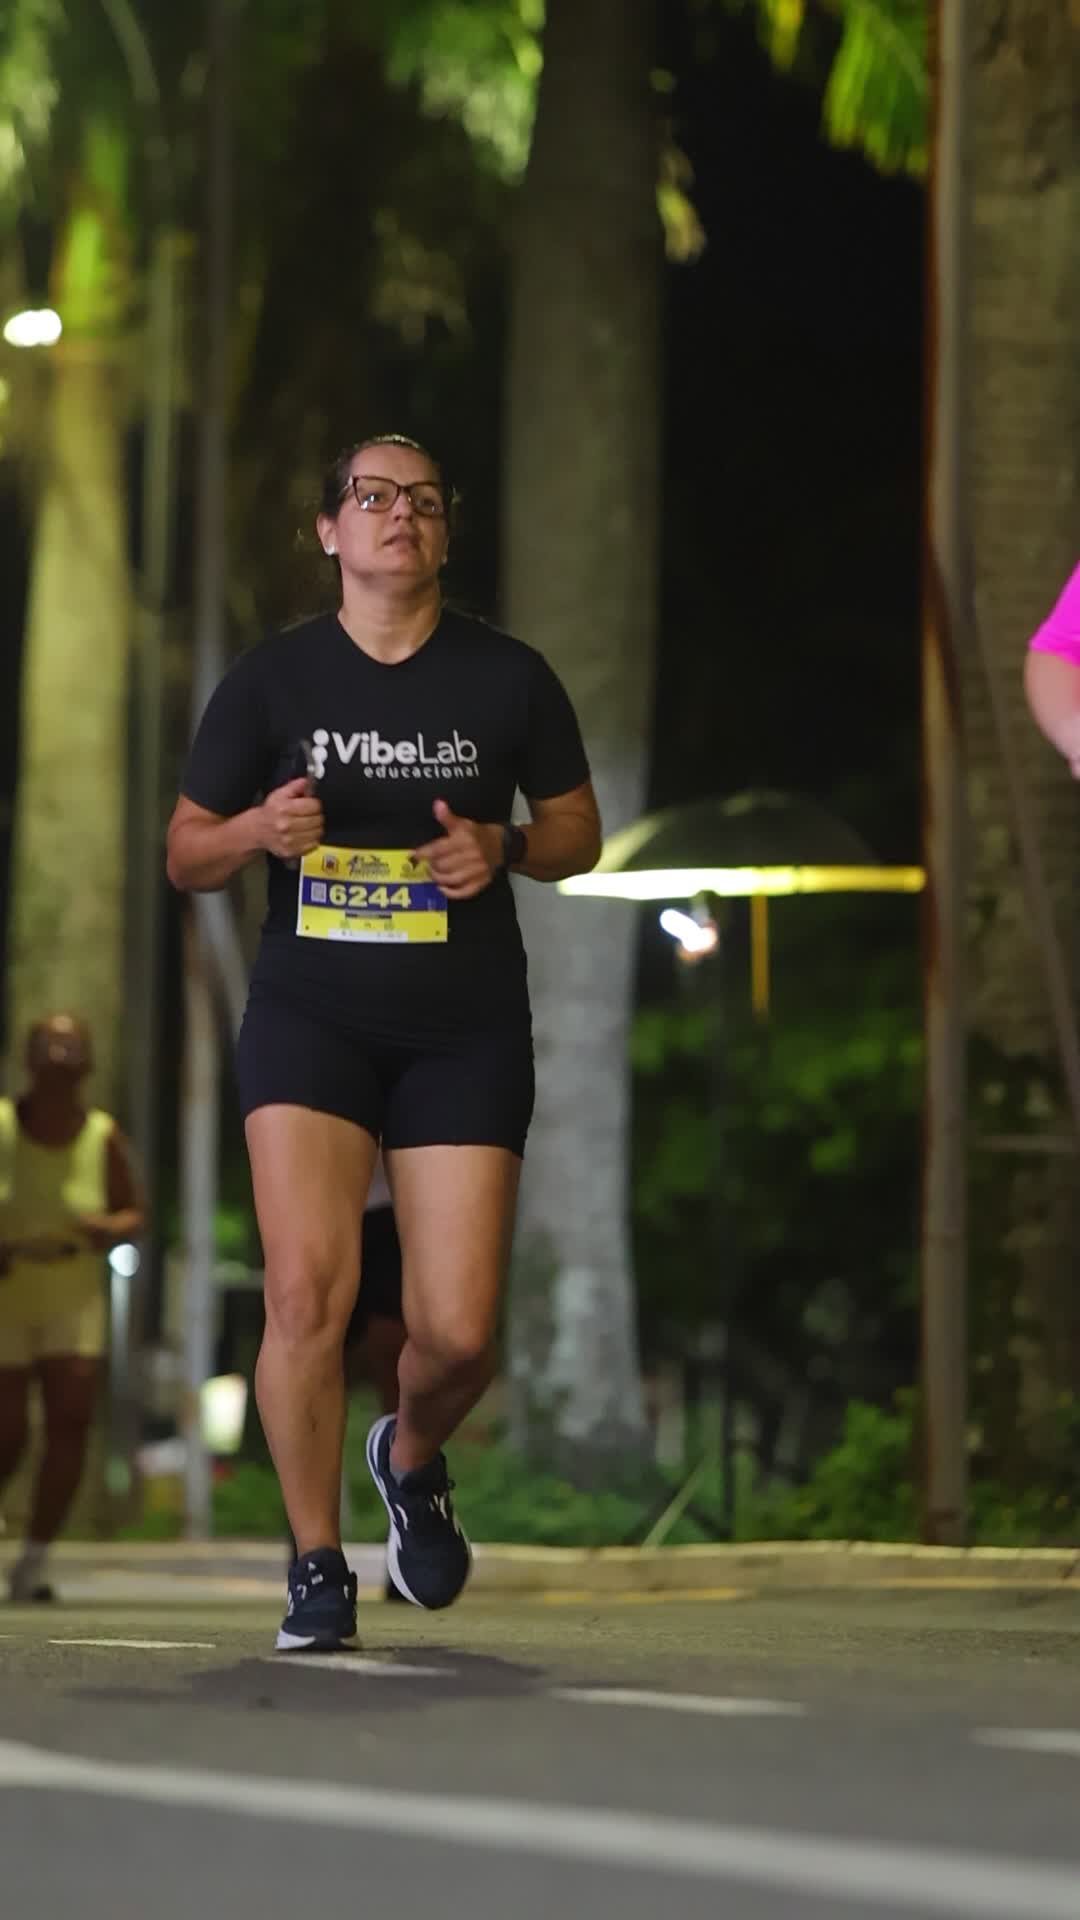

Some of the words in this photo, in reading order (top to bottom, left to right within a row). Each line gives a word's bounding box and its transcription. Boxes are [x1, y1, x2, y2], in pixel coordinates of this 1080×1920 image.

[331, 729, 478, 765] VibeLab
[363, 764, 479, 778] educacional
[329, 883, 412, 909] 6244
